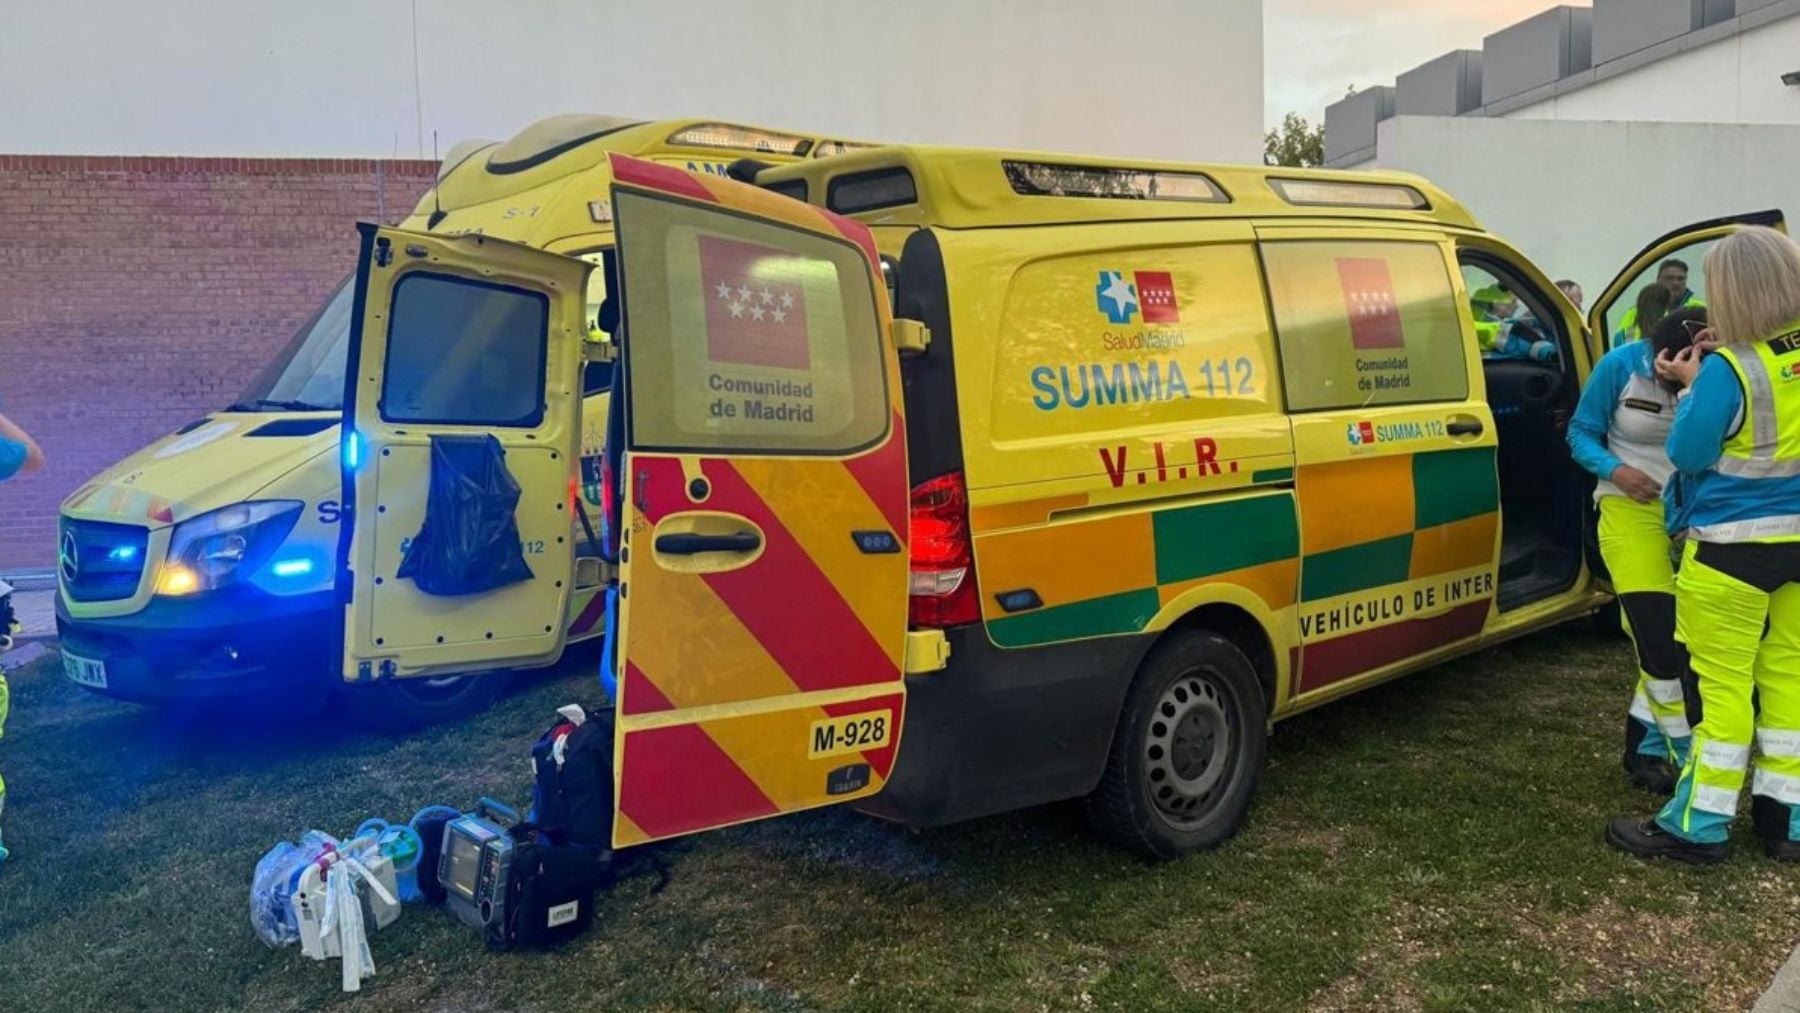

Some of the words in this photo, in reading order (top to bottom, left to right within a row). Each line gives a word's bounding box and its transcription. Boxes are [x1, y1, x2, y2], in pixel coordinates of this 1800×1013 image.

[1356, 357, 1408, 371] Comunidad
[709, 374, 812, 398] Comunidad
[1031, 360, 1190, 411] SUMMA
[1200, 357, 1254, 396] 112
[1358, 376, 1371, 390] de
[1375, 373, 1410, 389] Madrid
[711, 399, 736, 417] de
[744, 400, 814, 422] Madrid
[1376, 422, 1424, 442] SUMMA
[1425, 421, 1445, 437] 112
[1099, 437, 1238, 488] V.I.R.
[1300, 595, 1403, 637] VEHÍCULO
[1414, 587, 1435, 611] DE
[1445, 573, 1493, 602] INTER
[814, 717, 884, 752] M-928
